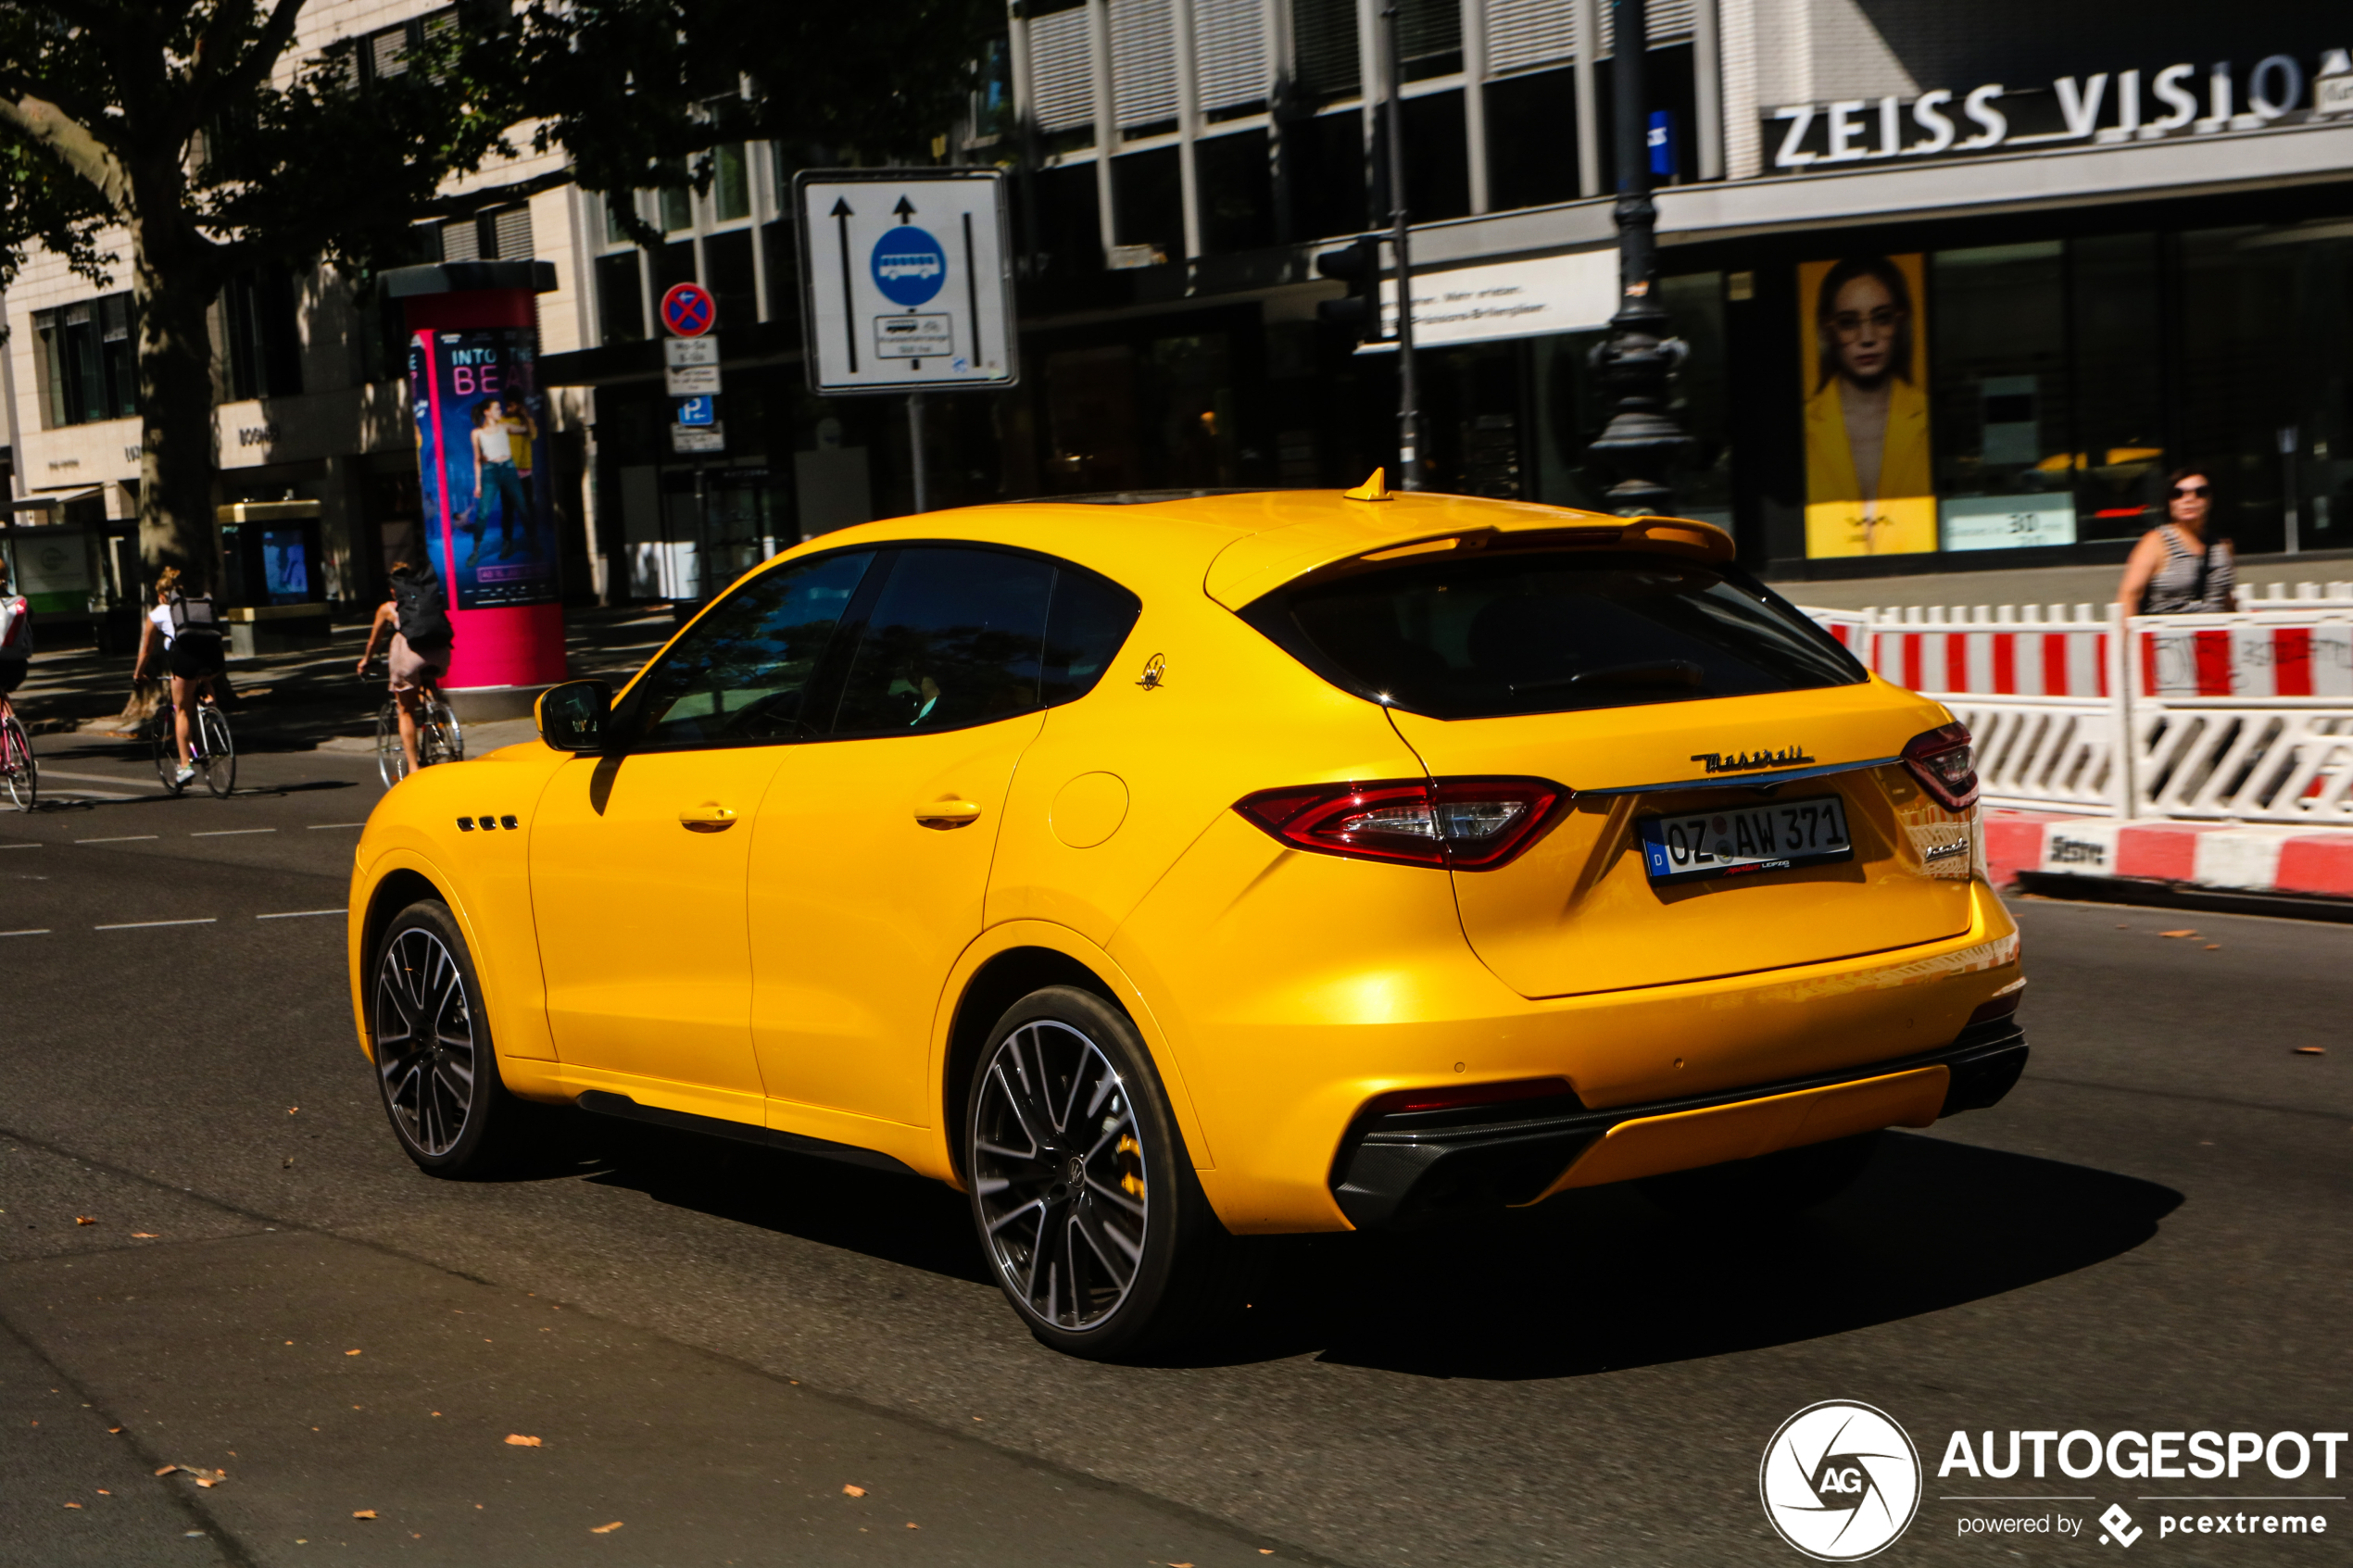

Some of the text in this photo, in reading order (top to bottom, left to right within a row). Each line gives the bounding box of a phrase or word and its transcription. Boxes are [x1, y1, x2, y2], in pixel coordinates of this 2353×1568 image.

[1774, 83, 2008, 168] ZEISS
[451, 347, 497, 367] INTO
[684, 396, 702, 421] P
[1691, 745, 1816, 773] Maserati
[1667, 804, 1845, 866] OZ AW 371
[1654, 853, 1663, 867] D
